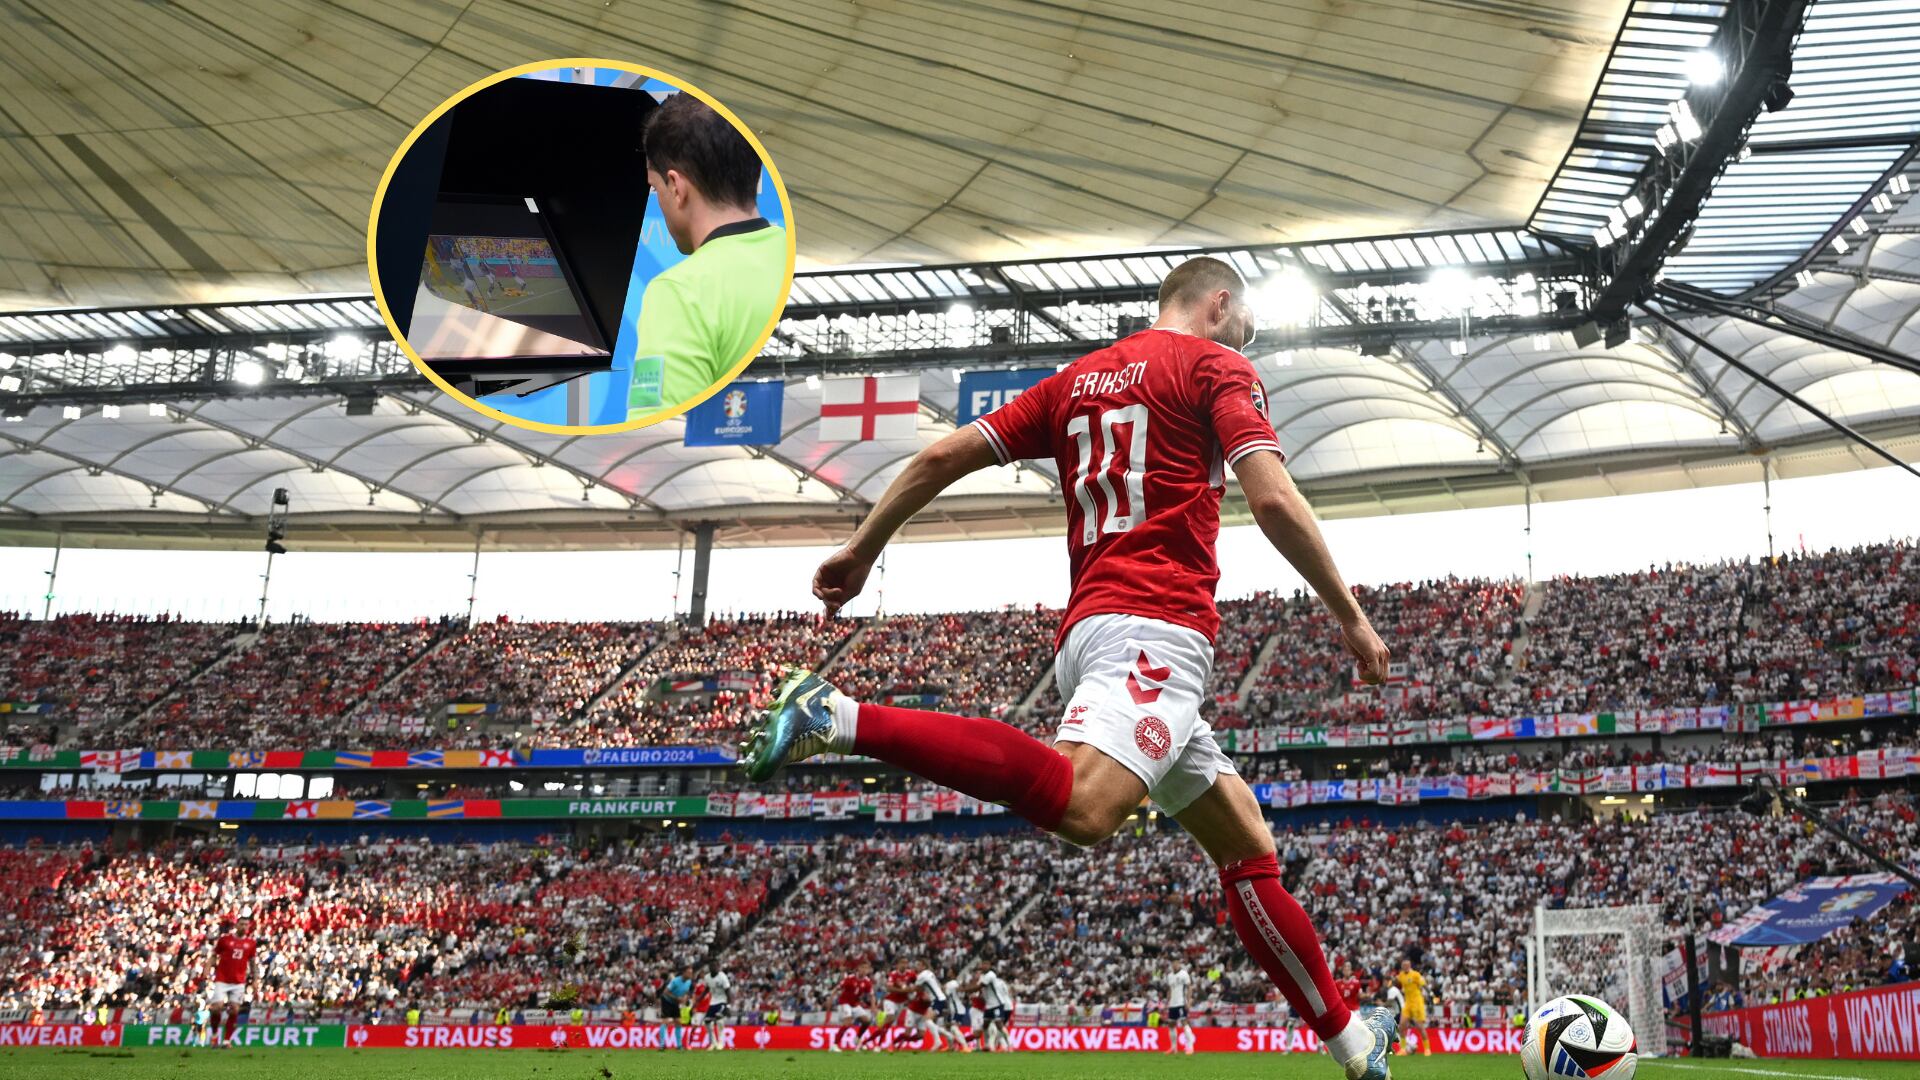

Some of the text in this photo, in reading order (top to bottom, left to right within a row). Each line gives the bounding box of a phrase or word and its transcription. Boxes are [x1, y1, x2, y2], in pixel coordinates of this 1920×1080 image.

[1071, 360, 1147, 397] ERIKSEN
[1067, 404, 1148, 546] 10
[1143, 725, 1166, 750] DBU
[569, 801, 676, 814] FRANKFURT
[1243, 890, 1287, 956] DANMARK
[404, 1027, 513, 1047] STRAUSS
[1009, 1027, 1159, 1050] WORKWEAR
[1762, 1004, 1812, 1054] STRAUSS
